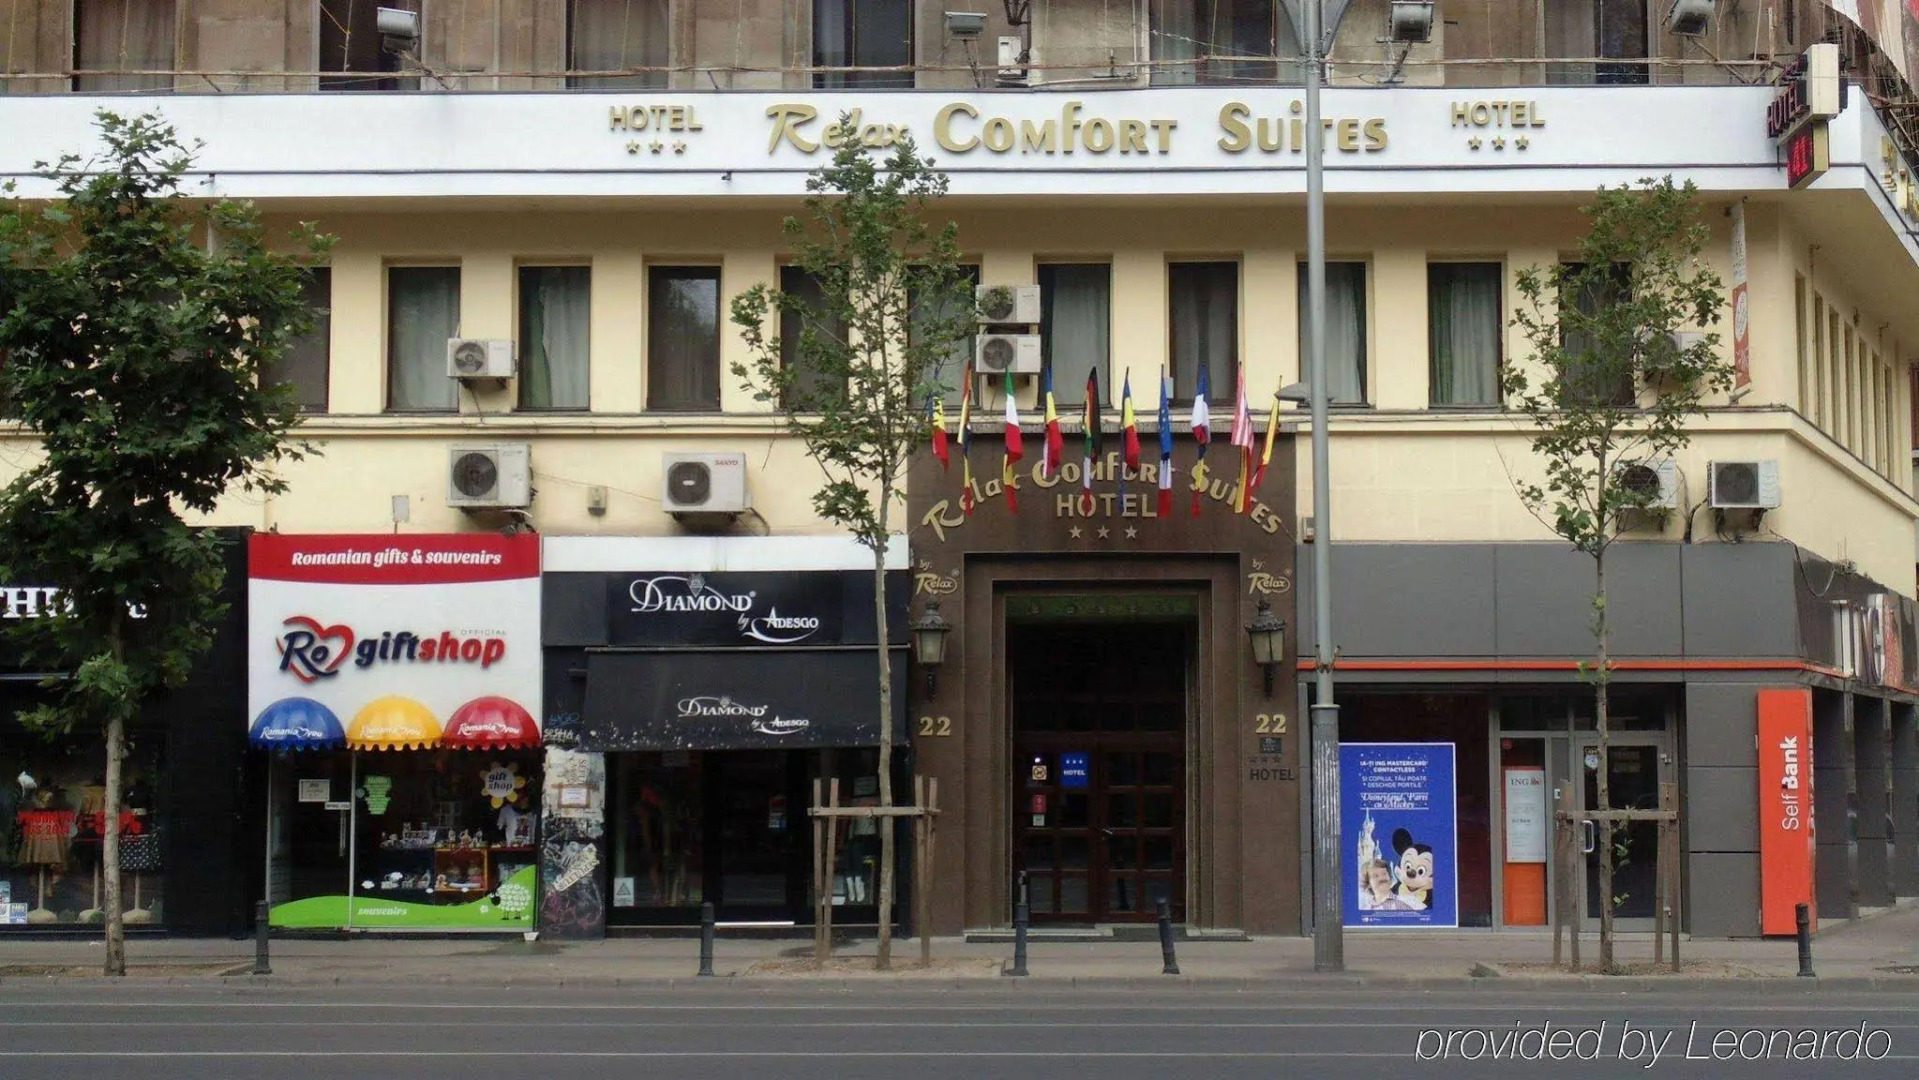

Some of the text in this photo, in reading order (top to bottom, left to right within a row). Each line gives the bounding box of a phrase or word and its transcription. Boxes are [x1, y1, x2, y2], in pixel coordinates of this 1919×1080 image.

[609, 105, 703, 131] HOTEL
[1451, 101, 1546, 126] HOTEL
[765, 103, 909, 156] Relax
[1056, 493, 1158, 517] HOTEL
[292, 548, 502, 568] Romanian gifts & souvenirs
[915, 573, 957, 595] Relax
[1248, 572, 1290, 594] Relax
[738, 613, 750, 630] by
[355, 631, 506, 669] giftshop
[260, 726, 323, 739] Romania you
[457, 723, 520, 735] Romania you
[919, 716, 951, 736] 22
[1255, 714, 1287, 734] 22
[489, 772, 507, 783] gift
[1063, 769, 1086, 777] HOTEL
[1250, 768, 1295, 781] HOTEL
[1510, 778, 1529, 786] ING
[1780, 735, 1799, 830] Self Bank
[488, 780, 513, 792] shop
[358, 906, 407, 916] souvenirs
